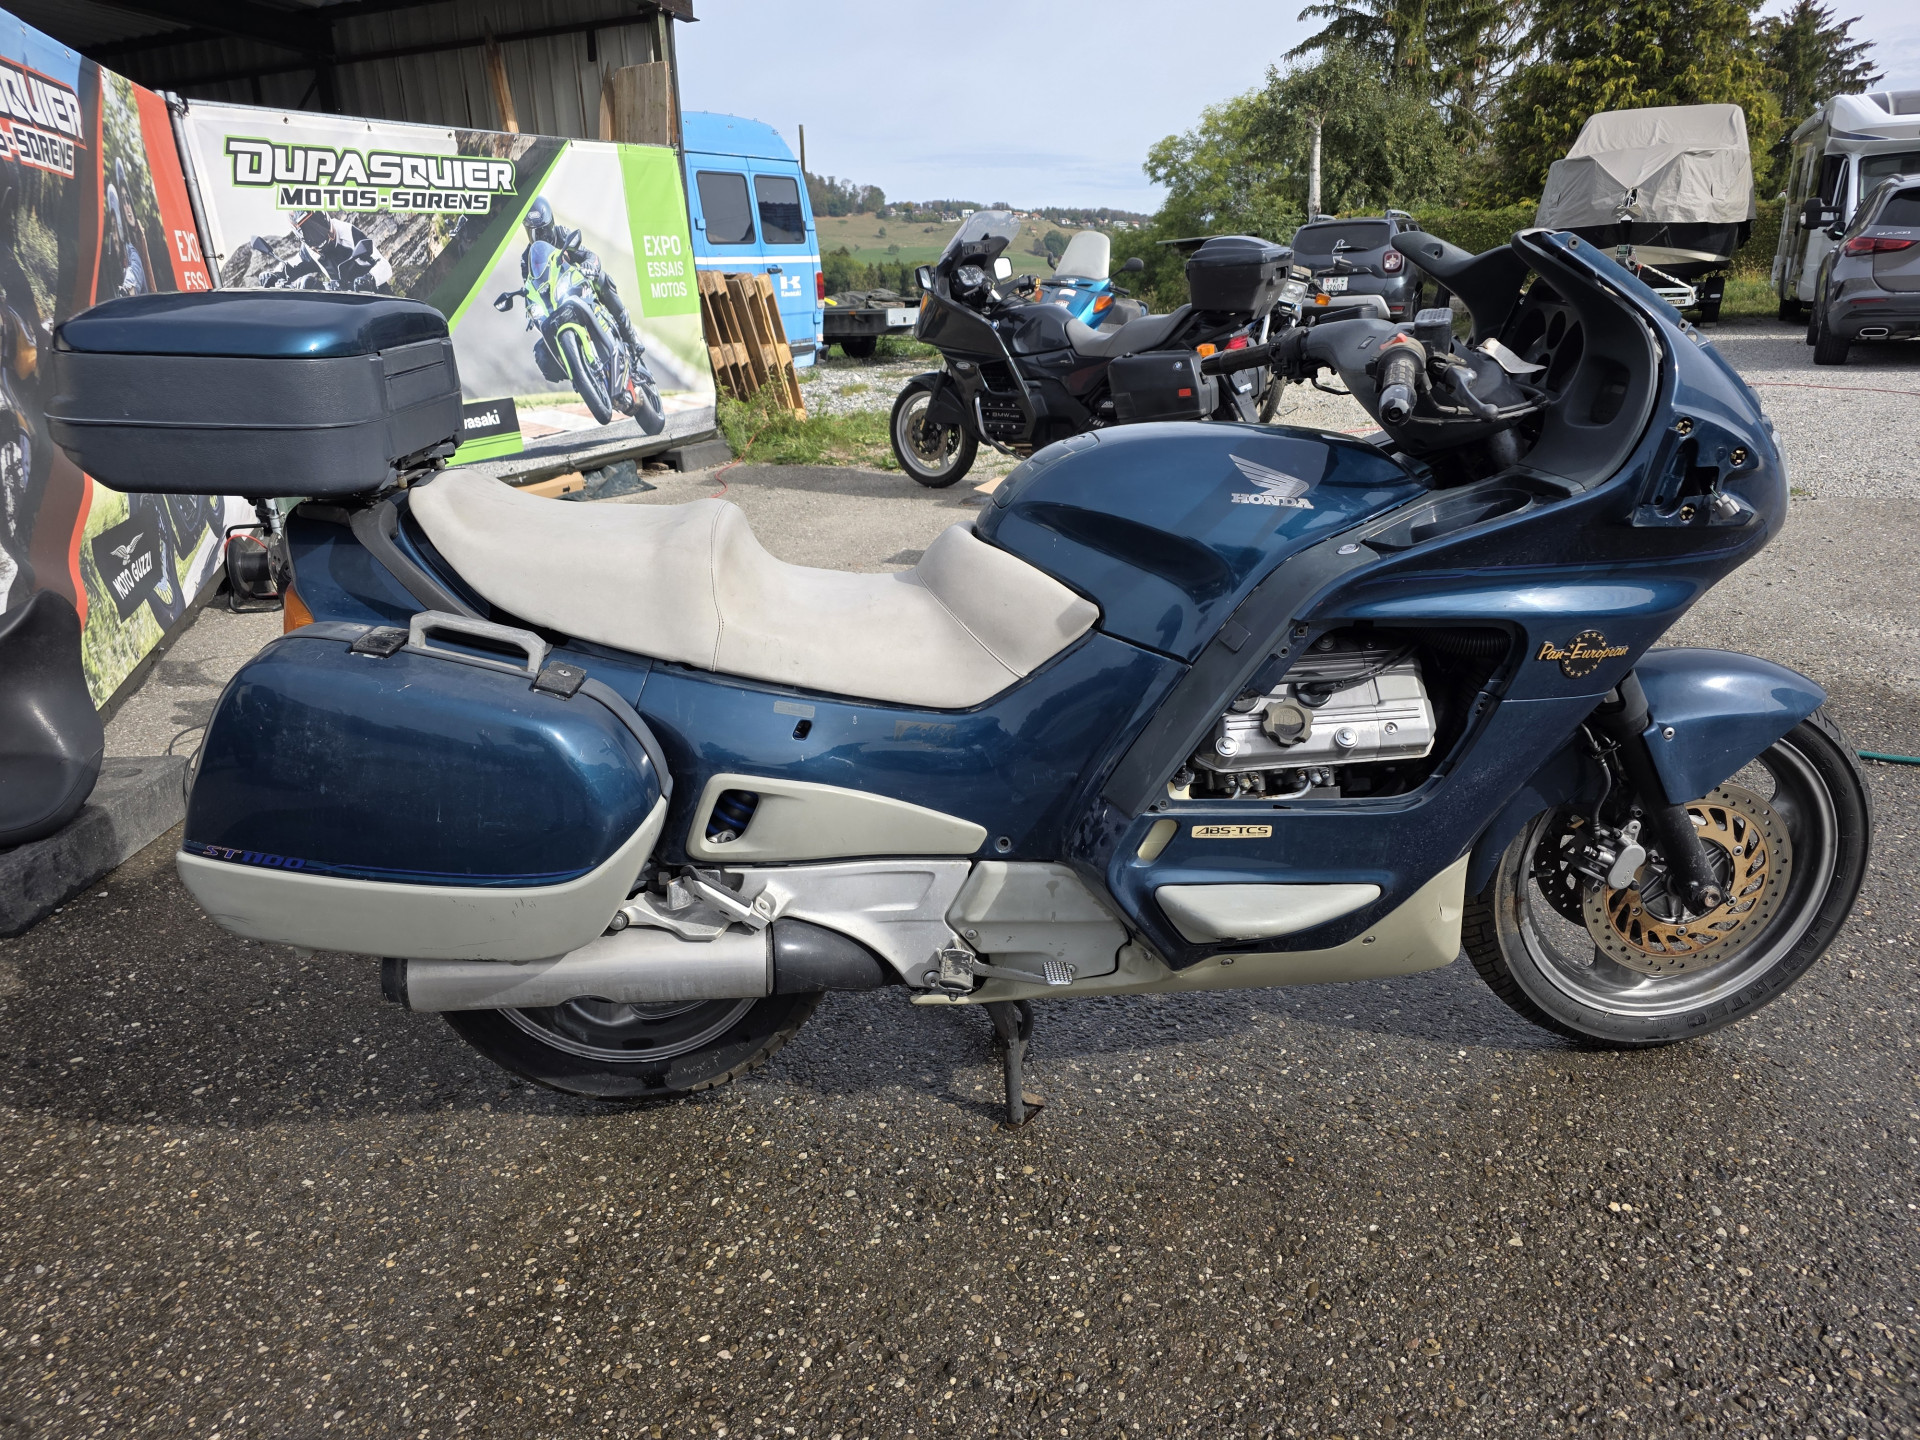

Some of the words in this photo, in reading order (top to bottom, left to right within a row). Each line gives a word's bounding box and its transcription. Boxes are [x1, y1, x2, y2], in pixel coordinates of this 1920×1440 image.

[0, 65, 83, 139] QUIER
[229, 140, 513, 191] DUPASQUIER
[643, 235, 682, 256] EXPO
[647, 261, 684, 277] ESSAIS
[650, 281, 688, 298] MOTOS
[464, 409, 501, 429] asaki
[1231, 493, 1315, 510] HONDA
[112, 568, 135, 600] MOTO
[131, 550, 153, 582] GUZZI
[1538, 642, 1629, 663] Pan-European
[1195, 826, 1269, 835] ABS-TCS
